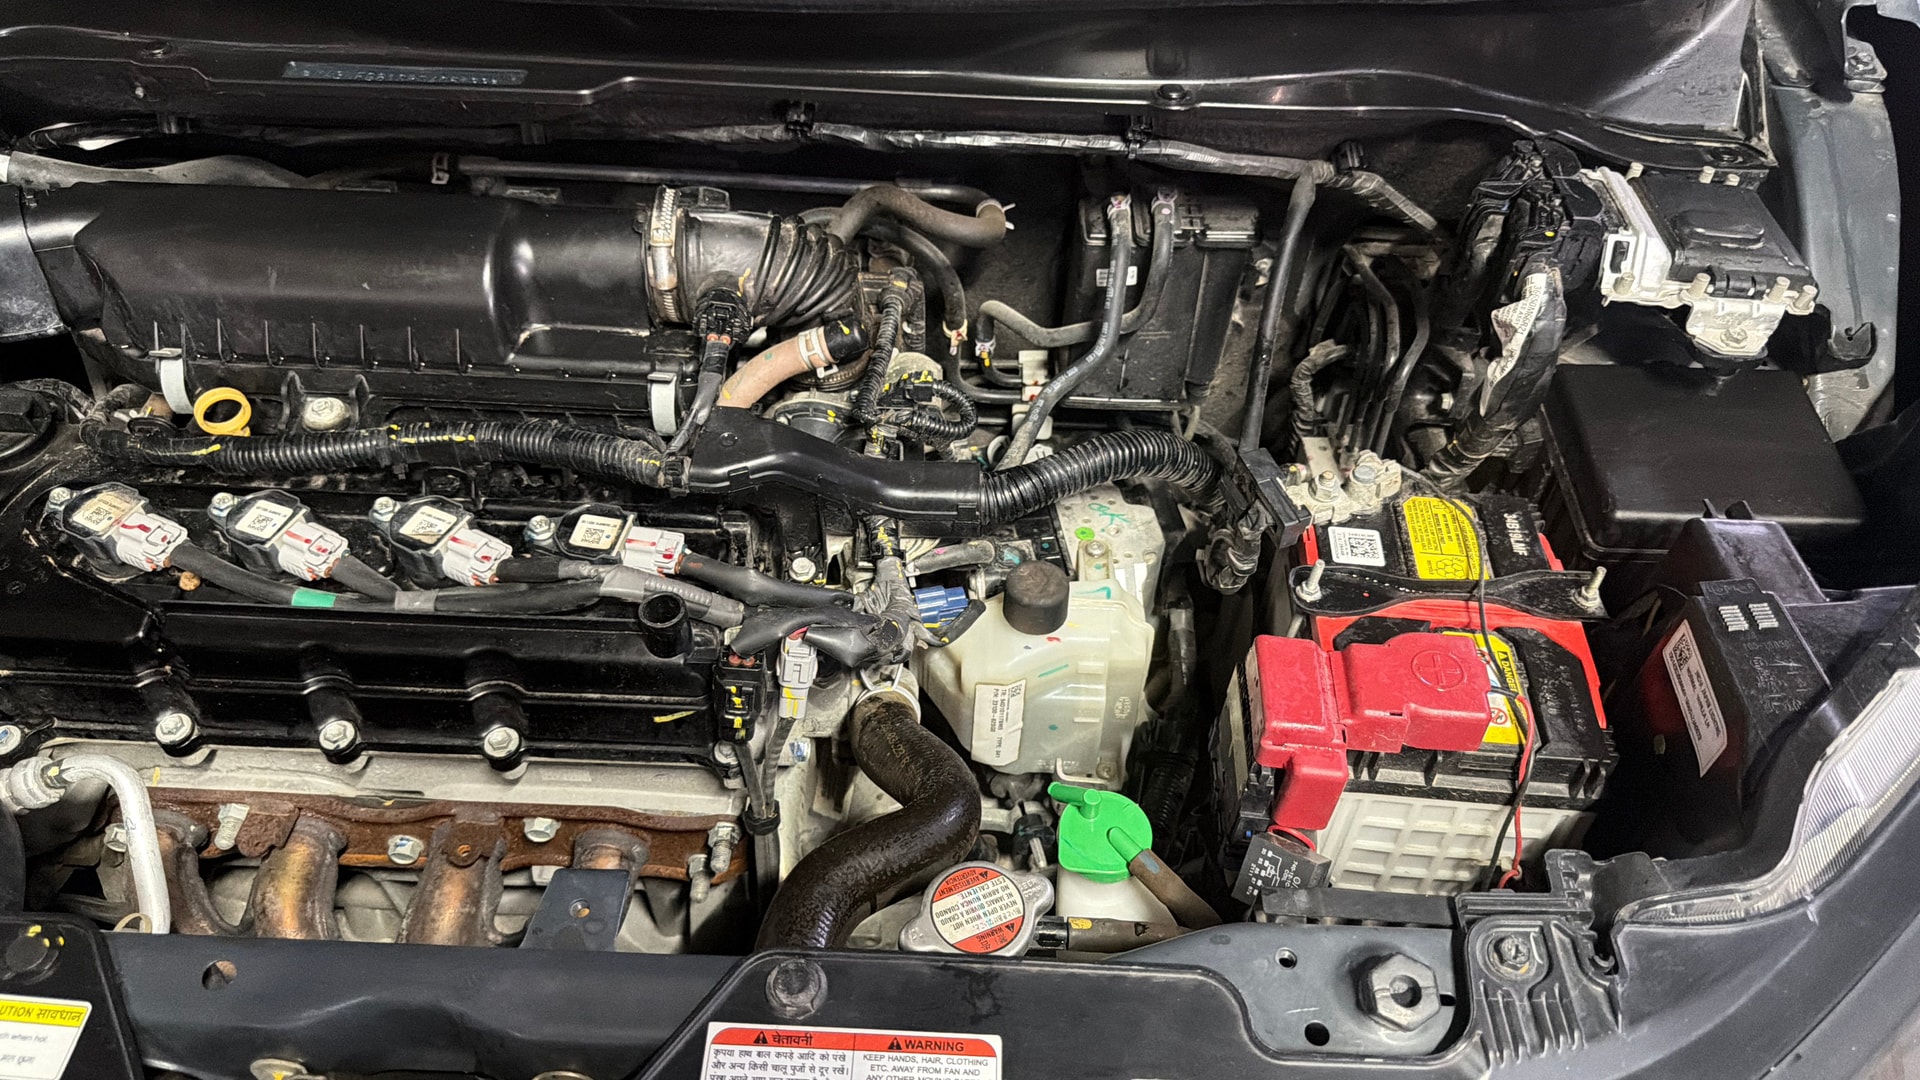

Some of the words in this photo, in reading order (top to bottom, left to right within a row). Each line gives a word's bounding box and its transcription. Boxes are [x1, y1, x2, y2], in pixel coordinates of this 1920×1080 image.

[945, 868, 976, 885] ADVERTENCIA
[990, 876, 1005, 886] ESTE
[938, 874, 980, 896] AVERTISSEMENT
[981, 888, 999, 899] ABRIR
[985, 894, 1004, 906] JAMAIS
[1004, 891, 1013, 899] NE
[960, 895, 980, 908] NUNCA
[998, 898, 1016, 910] NEVER
[934, 903, 959, 918] CUANDO
[964, 902, 985, 915] OUVRIR
[982, 906, 997, 917] OPEN
[964, 913, 981, 924] WHEN
[976, 926, 1002, 941] WARNING
[36, 1008, 83, 1021] सावधान
[771, 1031, 813, 1045] चेतावनी
[904, 1039, 964, 1052] WARNING
[713, 1048, 734, 1059] कृपया
[797, 1050, 815, 1060] आदि
[819, 1052, 829, 1061] को
[888, 1055, 918, 1063] HANDS,
[921, 1057, 943, 1065] HAIR,
[946, 1058, 988, 1066] CLOTHING
[711, 1060, 726, 1069] और
[748, 1060, 768, 1071] किसी
[808, 1063, 815, 1073] से
[870, 1064, 888, 1072] ETC.
